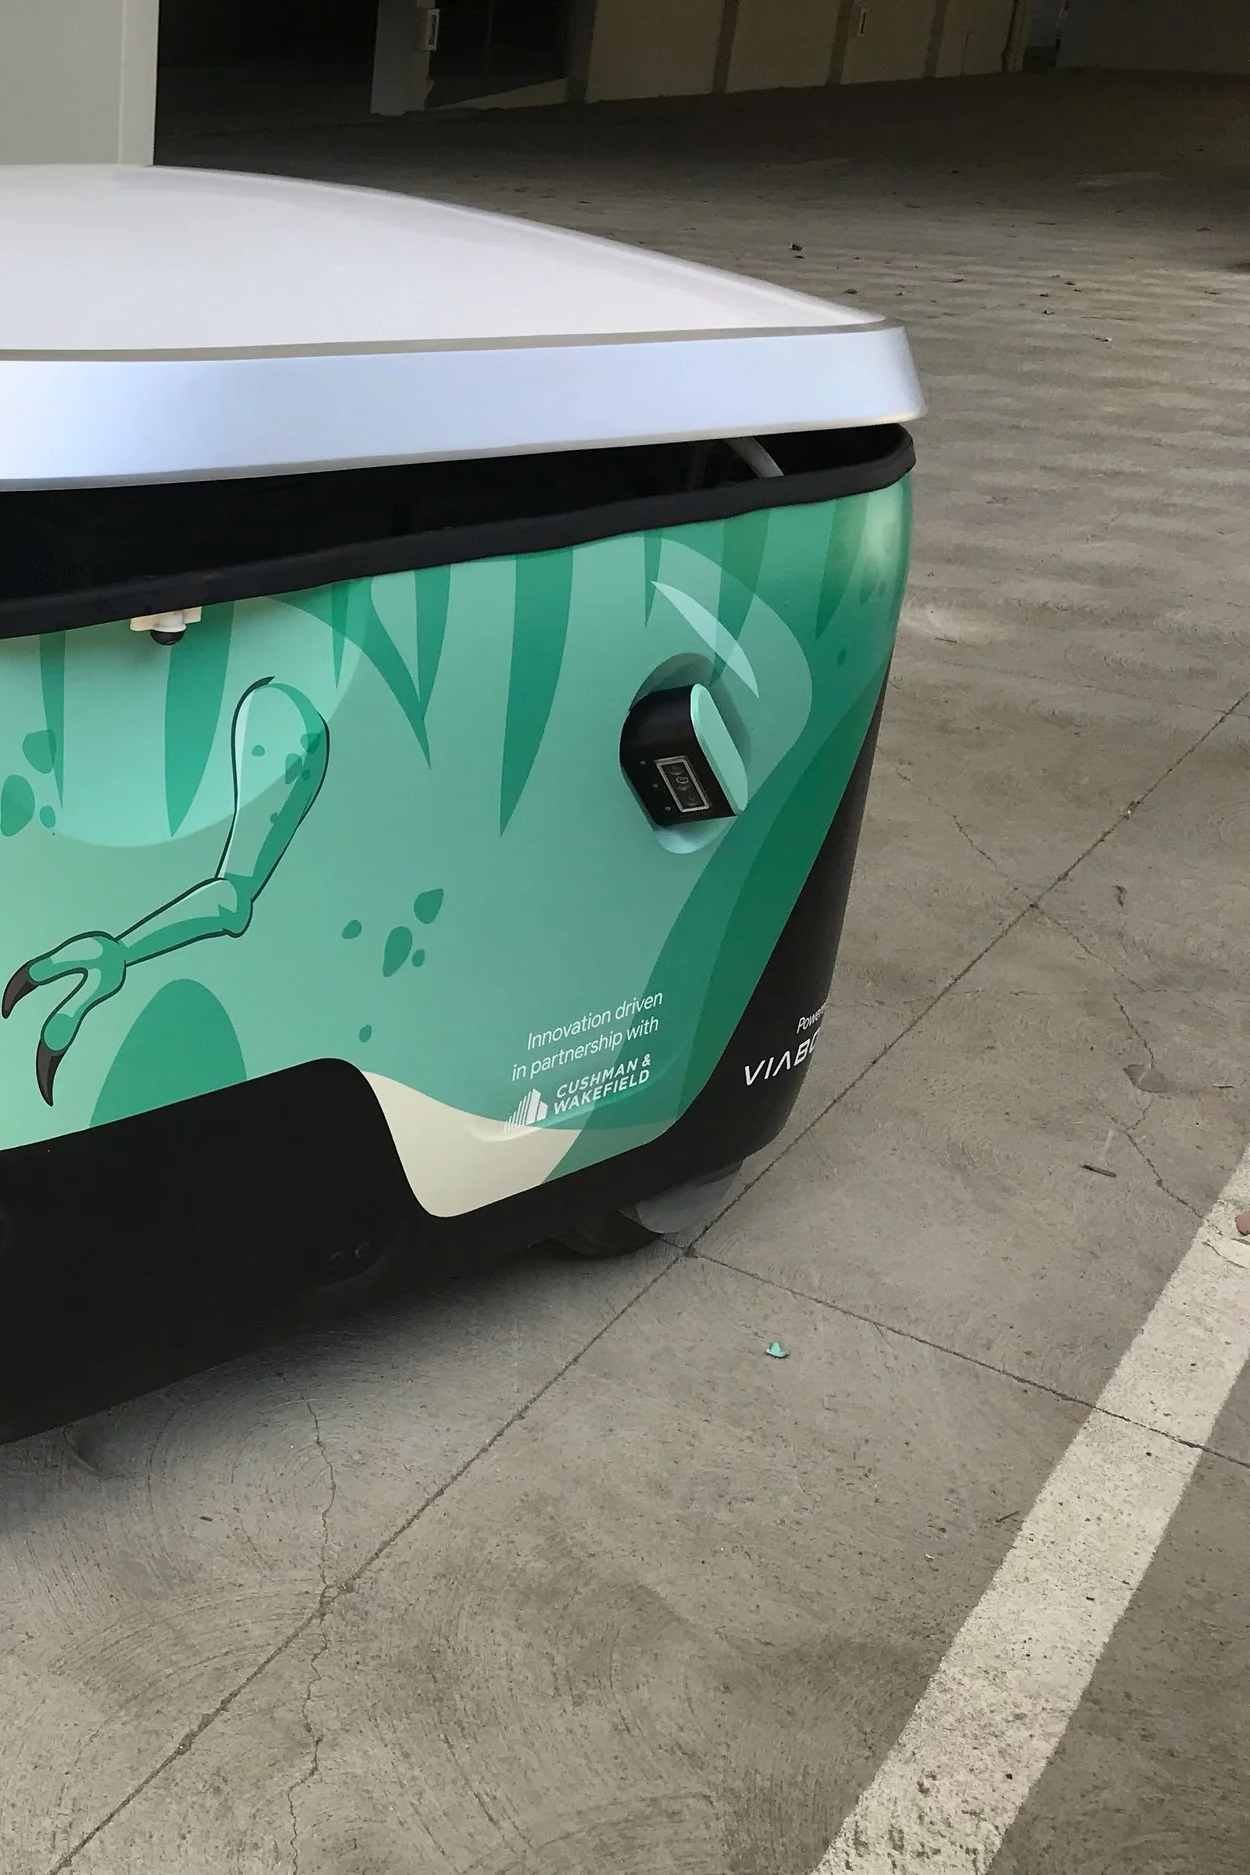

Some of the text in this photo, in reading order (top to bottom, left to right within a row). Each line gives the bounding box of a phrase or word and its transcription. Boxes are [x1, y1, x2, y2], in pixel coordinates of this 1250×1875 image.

[527, 992, 663, 1050] Innovation driven
[512, 1016, 659, 1082] in partnership with
[554, 1069, 650, 1115] WAKEFIELD
[556, 1053, 651, 1098] CUSHMAN &
